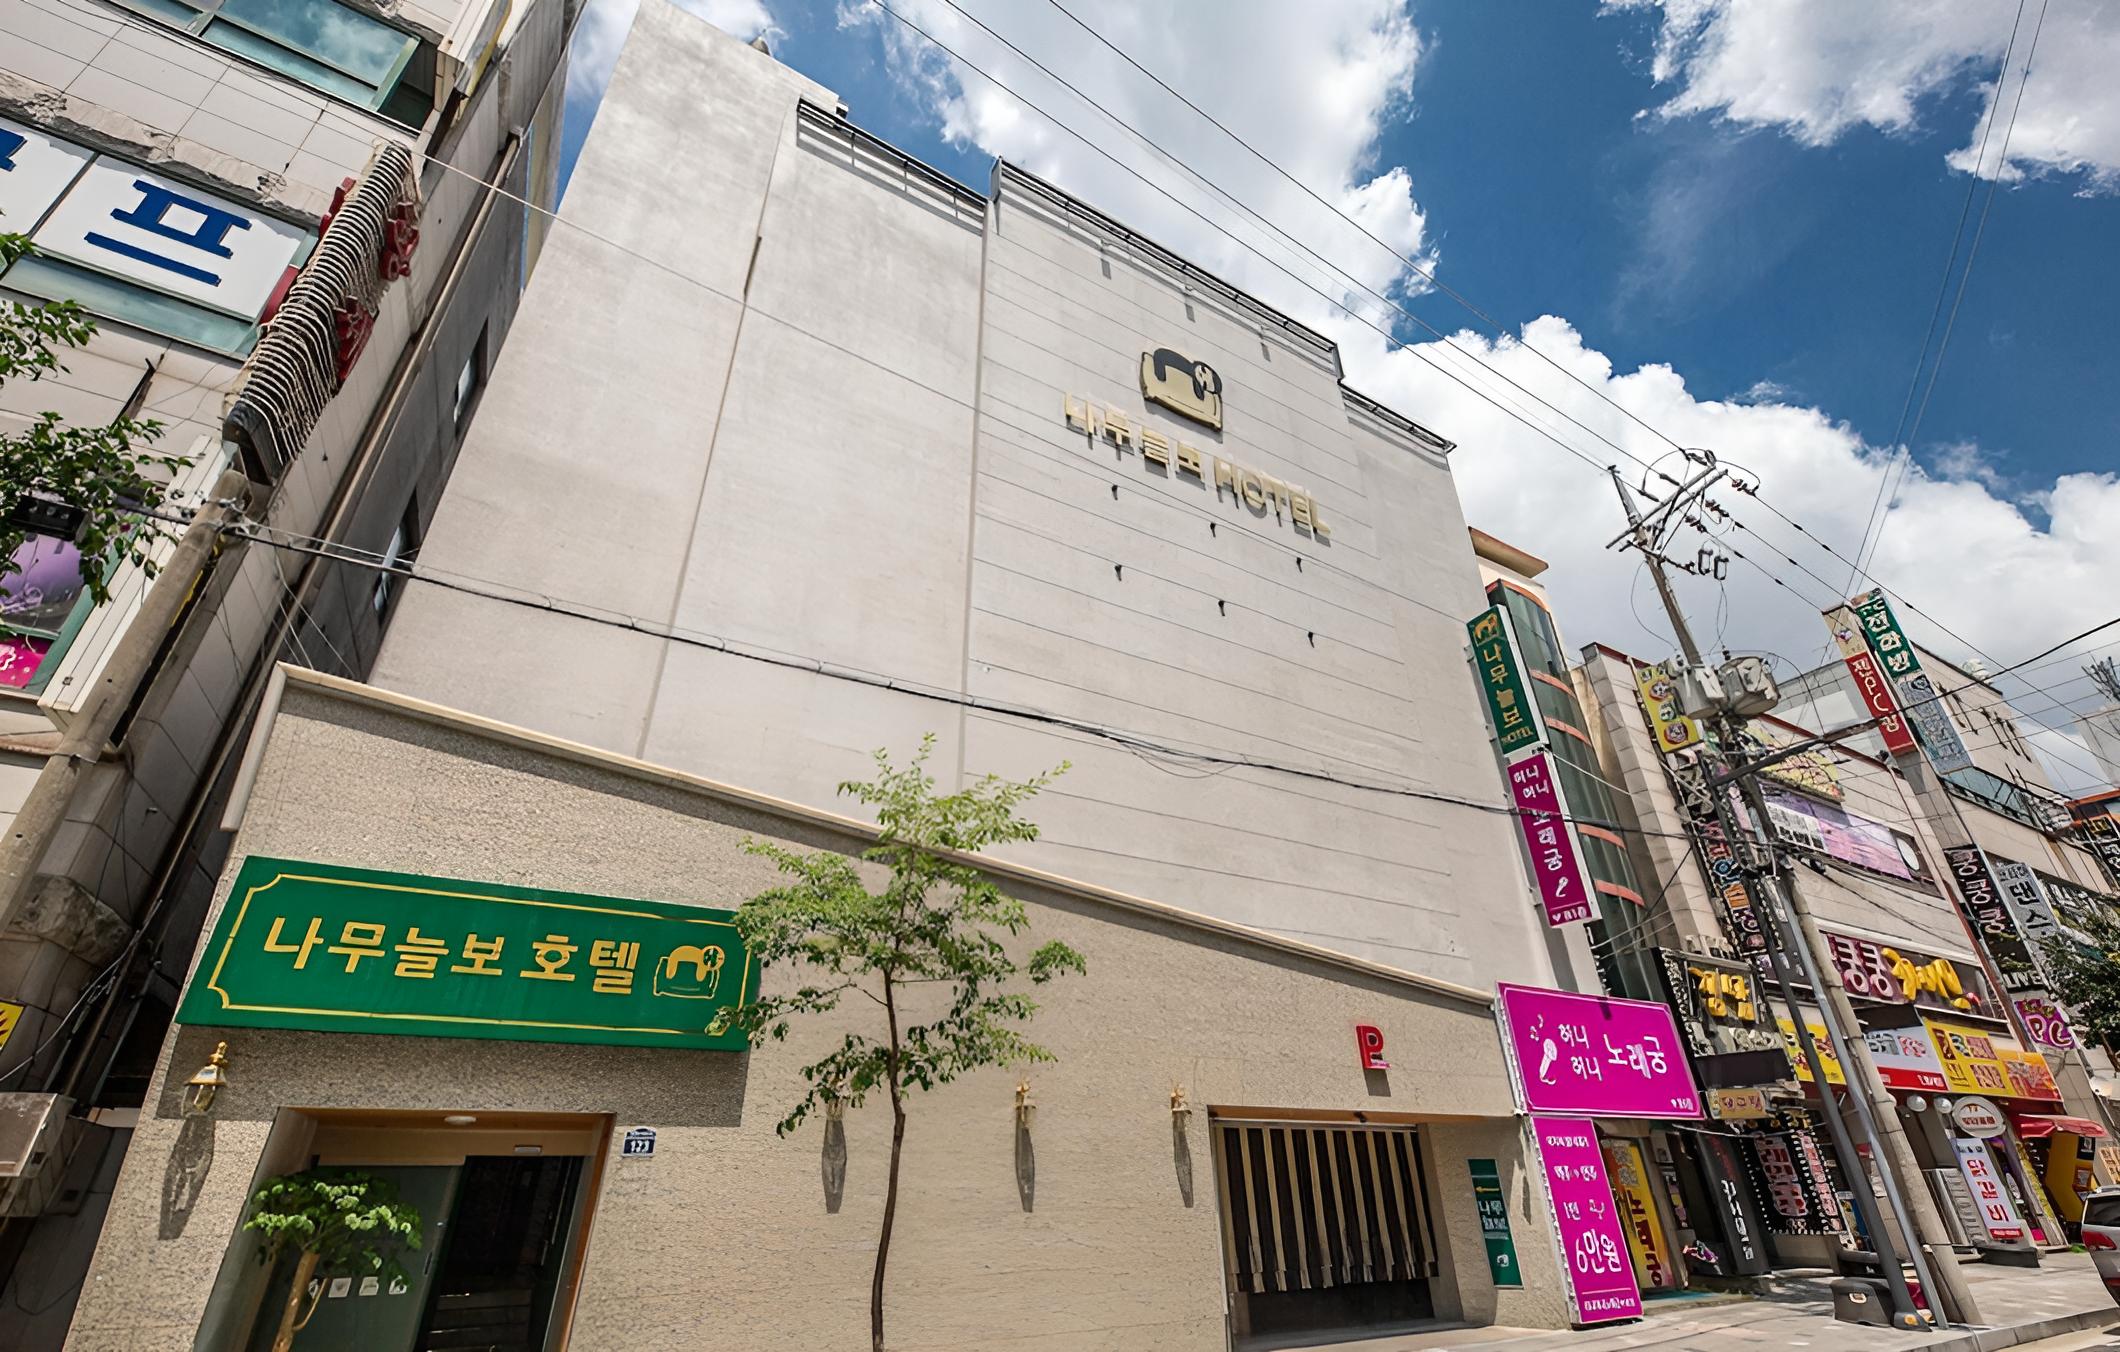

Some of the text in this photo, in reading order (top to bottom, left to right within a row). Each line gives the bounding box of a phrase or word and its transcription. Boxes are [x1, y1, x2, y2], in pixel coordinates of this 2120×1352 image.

[1213, 455, 1331, 537] HOTEL
[263, 917, 641, 995] 나무늘보 호텔
[1355, 1024, 1384, 1068] P
[1558, 1024, 1590, 1049] 허니
[1604, 1034, 1667, 1079] 노래궁
[1571, 1056, 1602, 1081] 허니
[1575, 1228, 1622, 1274] 6만원
